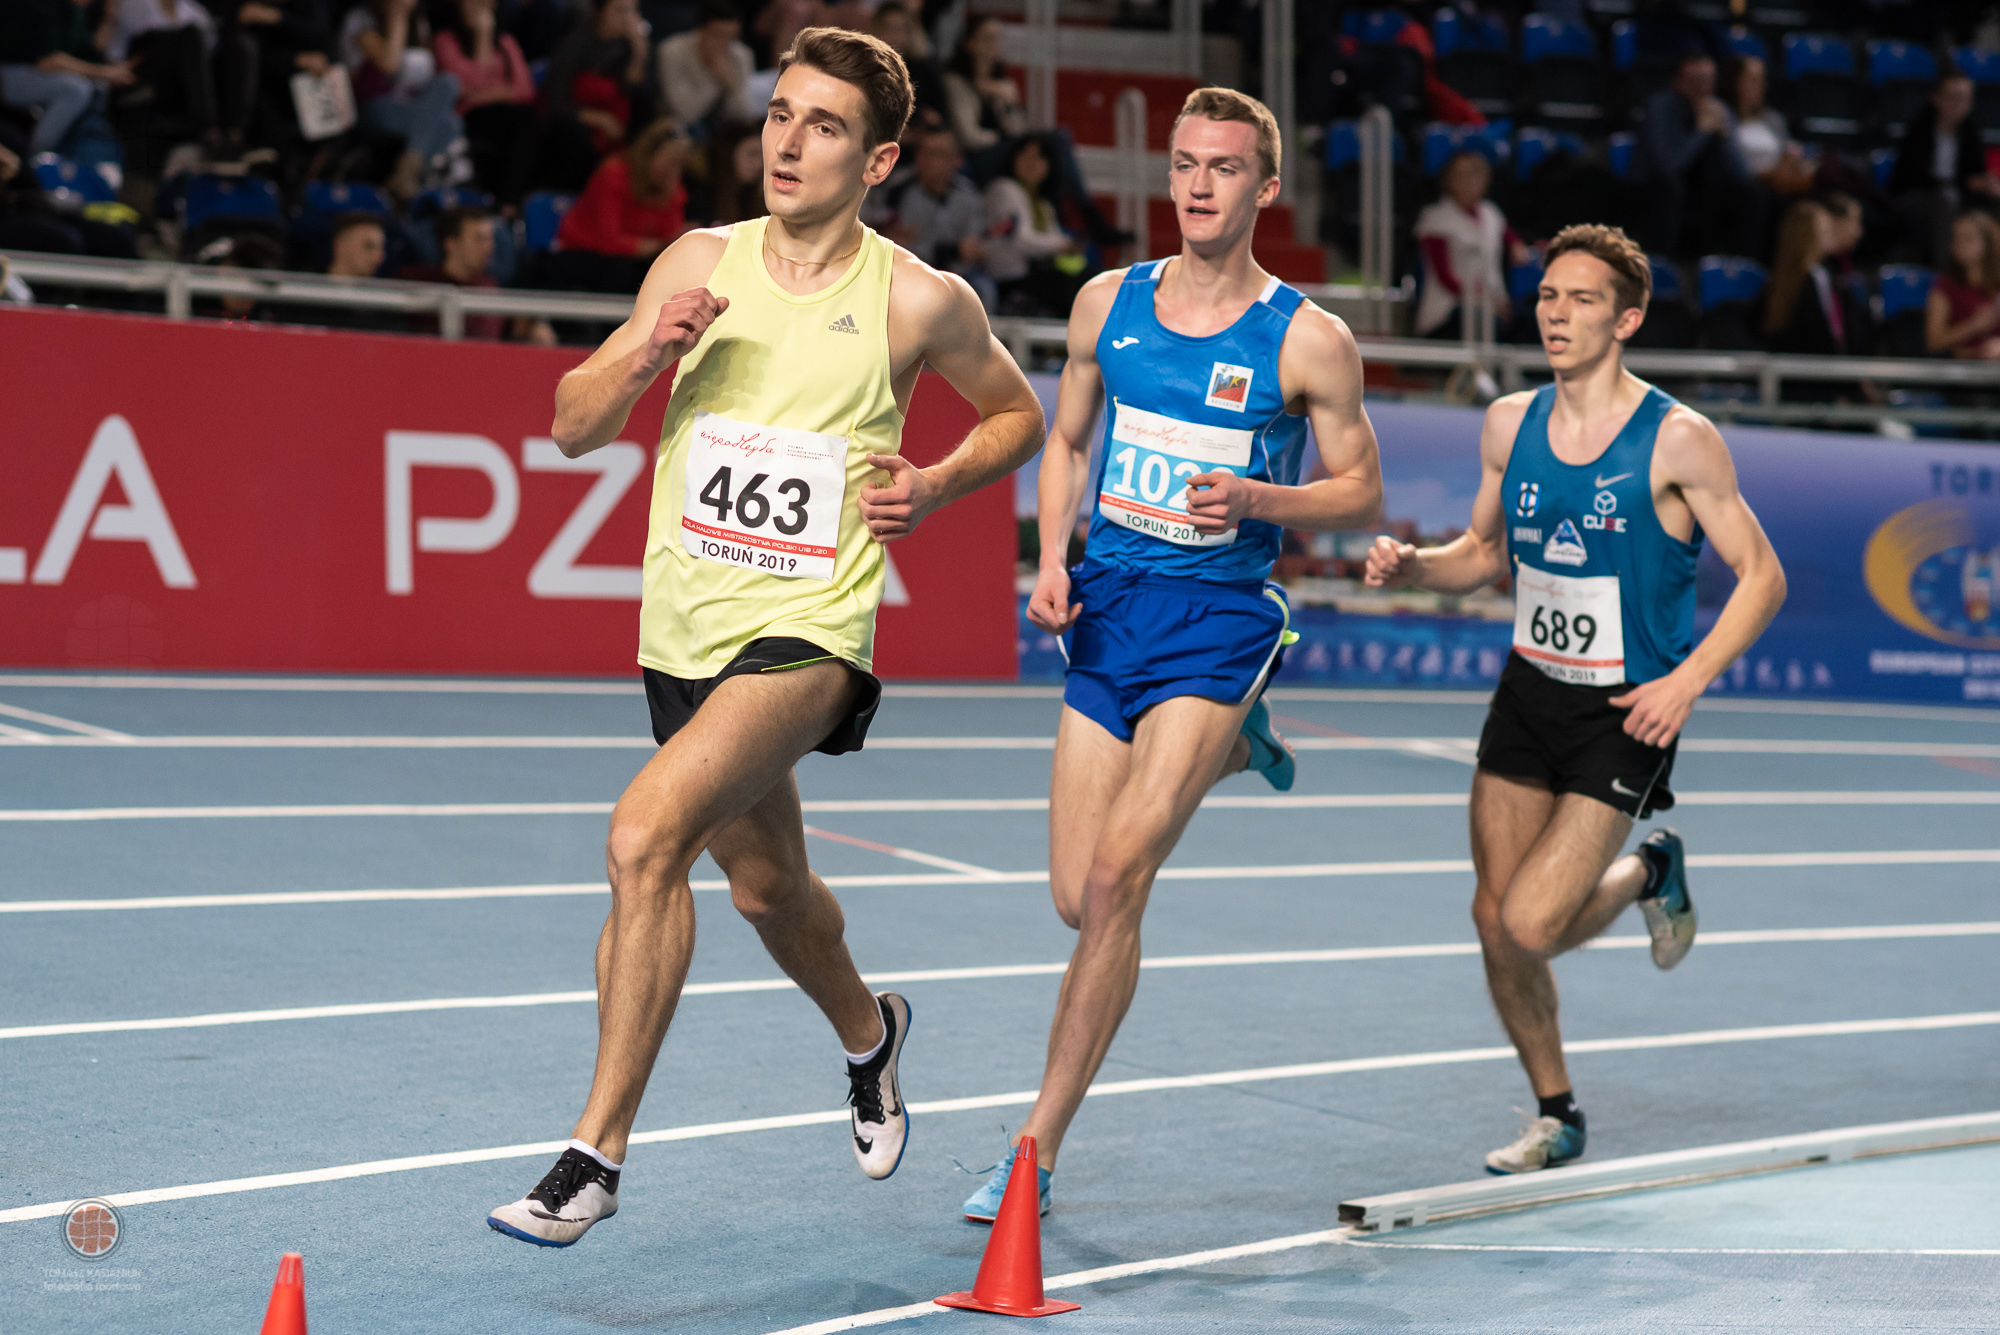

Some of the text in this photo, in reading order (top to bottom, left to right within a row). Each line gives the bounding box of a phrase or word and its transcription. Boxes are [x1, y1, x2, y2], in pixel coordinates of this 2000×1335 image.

[828, 323, 860, 335] adidas
[700, 465, 811, 536] 463
[683, 519, 828, 555] PZLA HALOWE MISTRZOSTWA POLSKI U18 U20
[1126, 513, 1169, 536] TORUŃ
[1583, 514, 1627, 533] CUBE
[701, 540, 798, 572] TORUŃ 2019
[1530, 605, 1597, 655] 689
[1569, 668, 1597, 681] 2019
